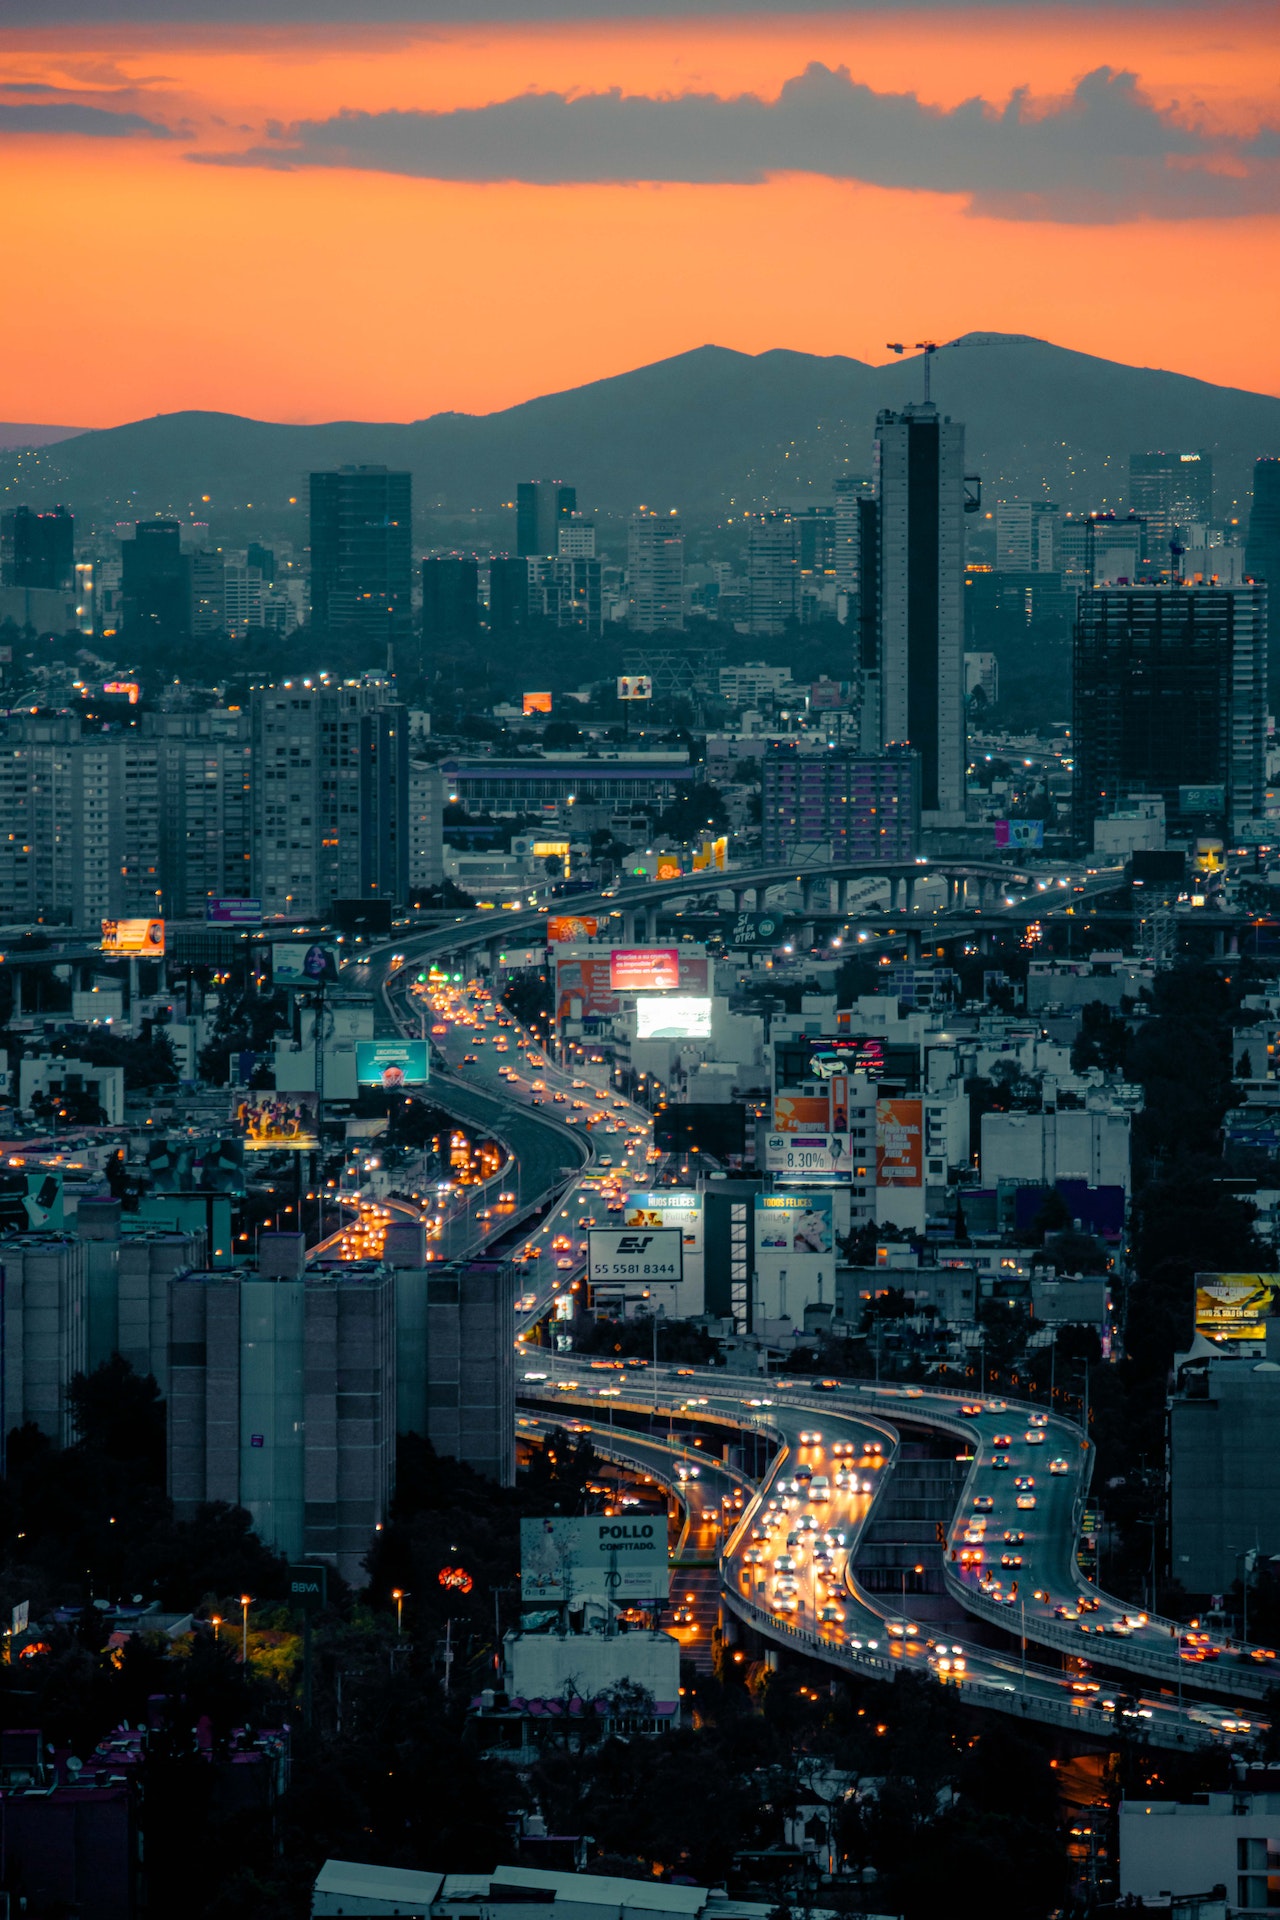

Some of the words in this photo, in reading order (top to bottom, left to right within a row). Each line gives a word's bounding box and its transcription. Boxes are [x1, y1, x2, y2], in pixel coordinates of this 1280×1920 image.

[1180, 454, 1201, 462] BBVA
[1187, 791, 1201, 801] 5G
[735, 931, 756, 943] OTRA
[787, 1152, 825, 1168] 8.30%
[667, 1197, 696, 1207] FELICES
[763, 1198, 785, 1207] TODOS
[785, 1197, 812, 1207] FELICES
[595, 1264, 609, 1274] 55
[613, 1263, 640, 1274] 5581
[643, 1264, 675, 1273] 8344
[599, 1525, 654, 1540] POLLO
[599, 1542, 656, 1551] CONFITADO.
[291, 1582, 319, 1593] BBVA
